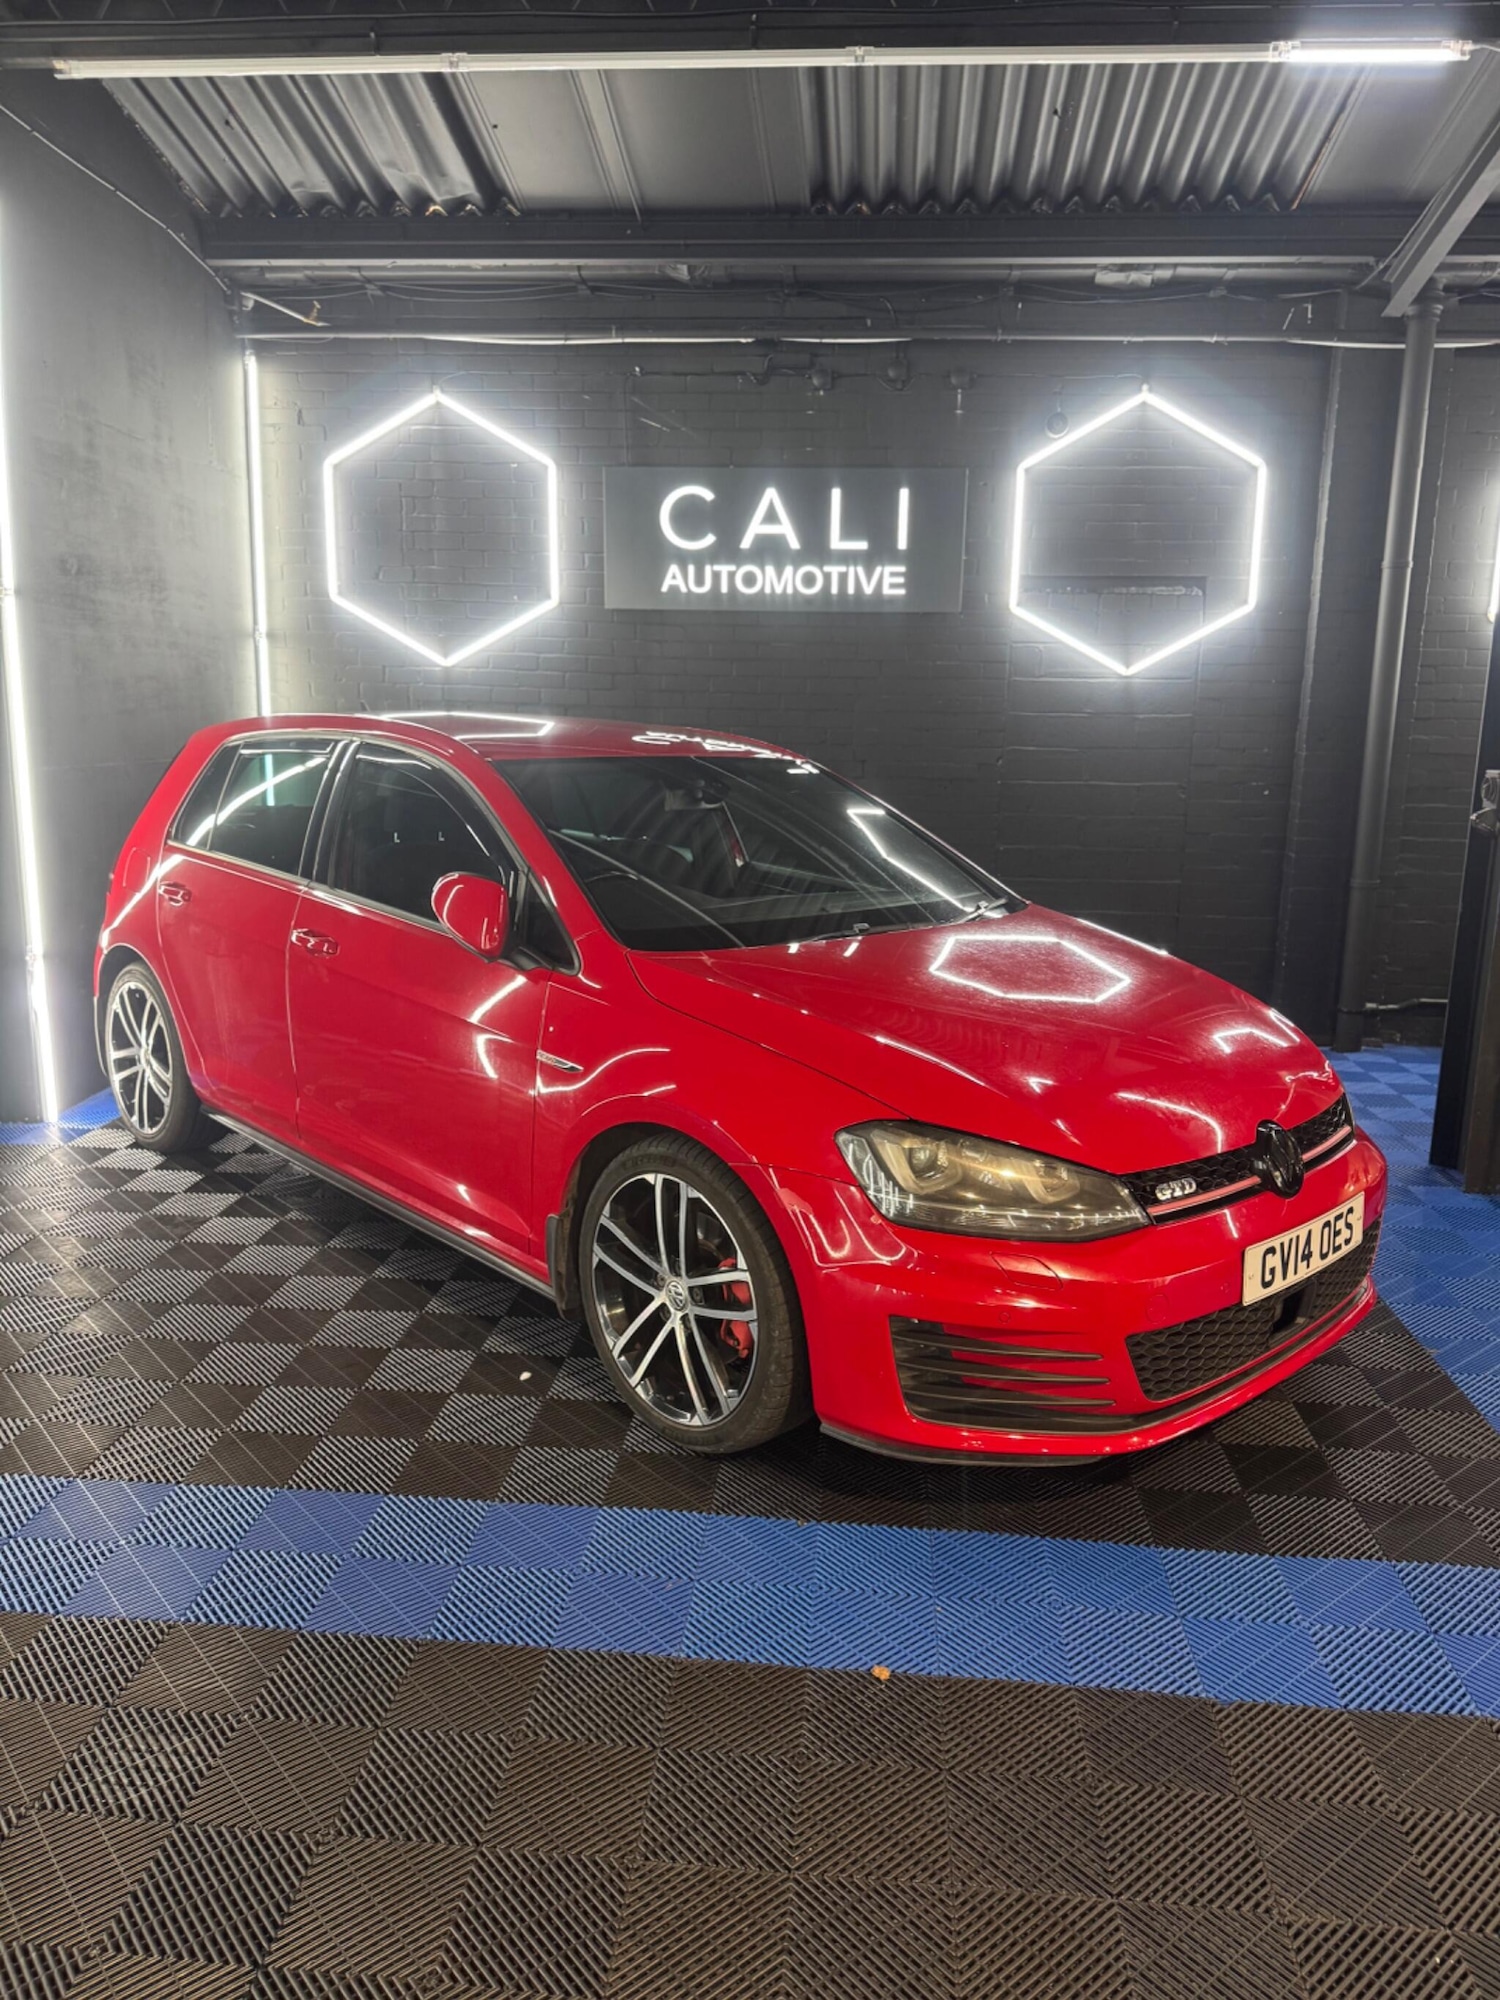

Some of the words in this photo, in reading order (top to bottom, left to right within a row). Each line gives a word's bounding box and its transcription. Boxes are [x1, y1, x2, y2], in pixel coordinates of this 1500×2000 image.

[658, 485, 910, 551] CALI
[660, 563, 907, 595] AUTOMOTIVE
[1154, 1177, 1198, 1201] GTD
[1260, 1228, 1313, 1290] GV14
[1319, 1205, 1354, 1261] OES
